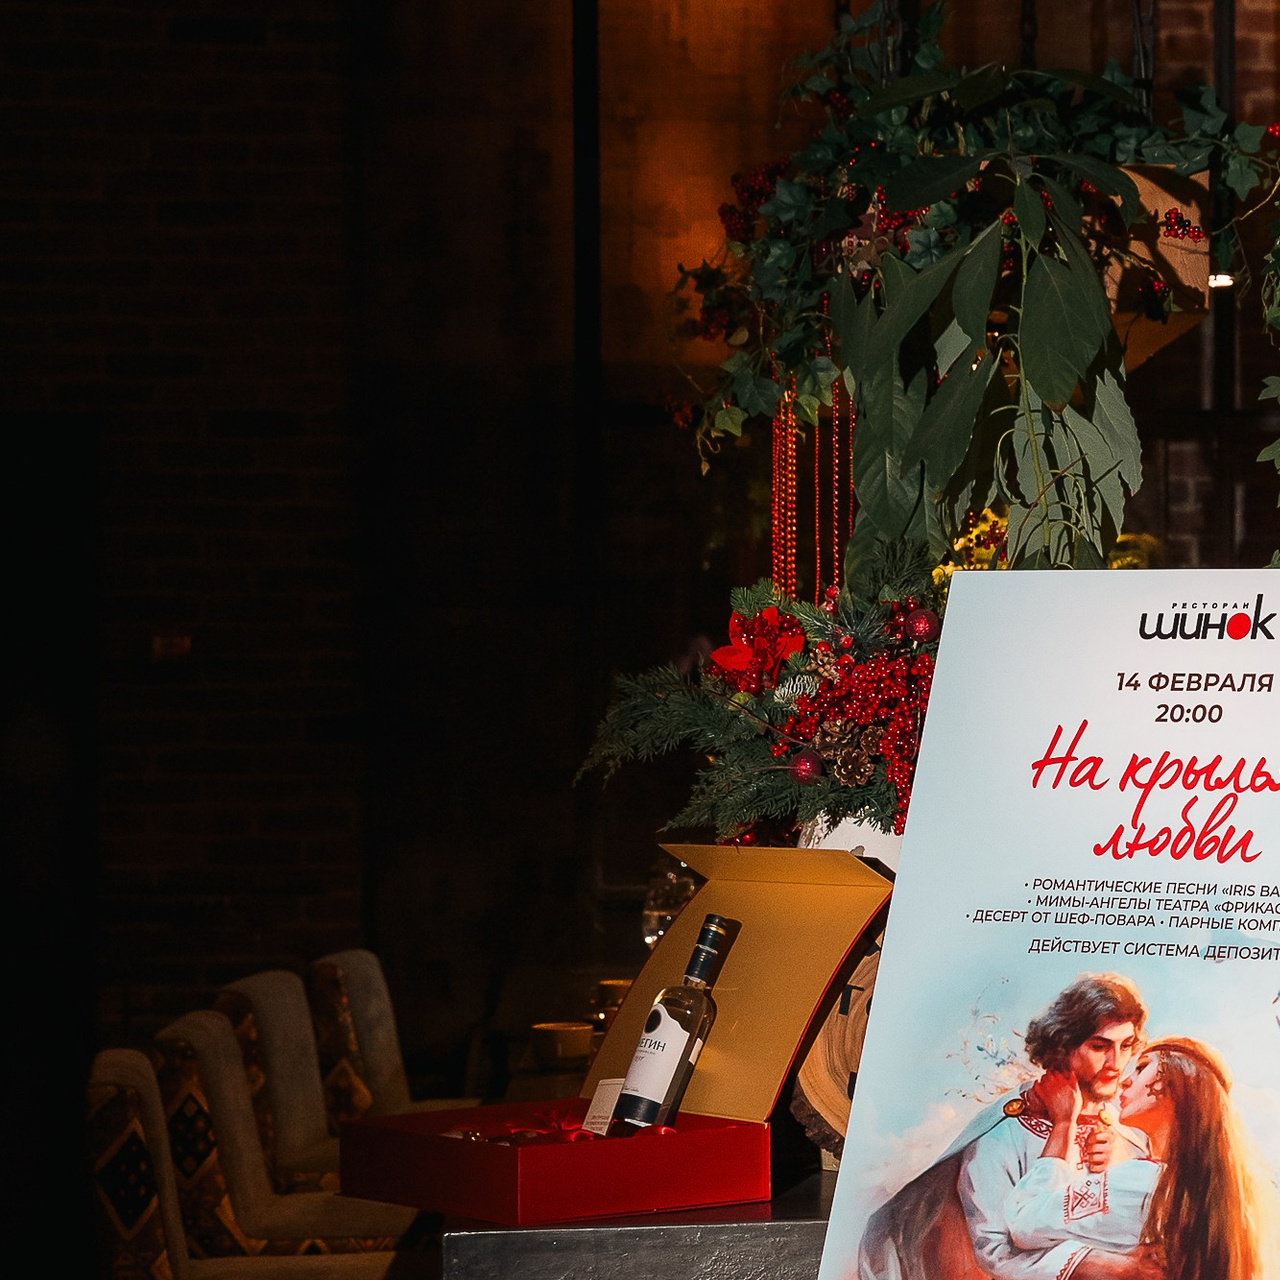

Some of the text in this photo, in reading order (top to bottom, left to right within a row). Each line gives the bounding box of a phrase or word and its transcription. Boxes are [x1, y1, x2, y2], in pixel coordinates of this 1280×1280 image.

[1171, 602, 1250, 610] РЕСТОРАН
[1116, 671, 1275, 693] 14 ФЕВРАЛЯ
[1154, 703, 1224, 723] 20:00
[1031, 719, 1110, 790] На
[1093, 792, 1263, 864] любви
[1032, 878, 1162, 894] РОМАНТИЧЕСКИЕ
[1166, 882, 1218, 896] ПЕСНИ
[1222, 884, 1256, 897] «IRIS
[1036, 895, 1152, 910] МИМЫ-АНГЕЛЫ
[1155, 897, 1210, 913] ТЕАТРА
[972, 909, 1028, 923] ДЕСЕРТ
[1031, 911, 1051, 924] ОТ
[1054, 912, 1156, 927] ШЕФ-ПОВАРА
[1168, 916, 1234, 930] ПАРНЫЕ
[1028, 936, 1120, 955] ДЕЙСТВУЕТ
[1123, 941, 1200, 958] СИСТЕМА
[638, 1037, 667, 1052] ЕГИН
